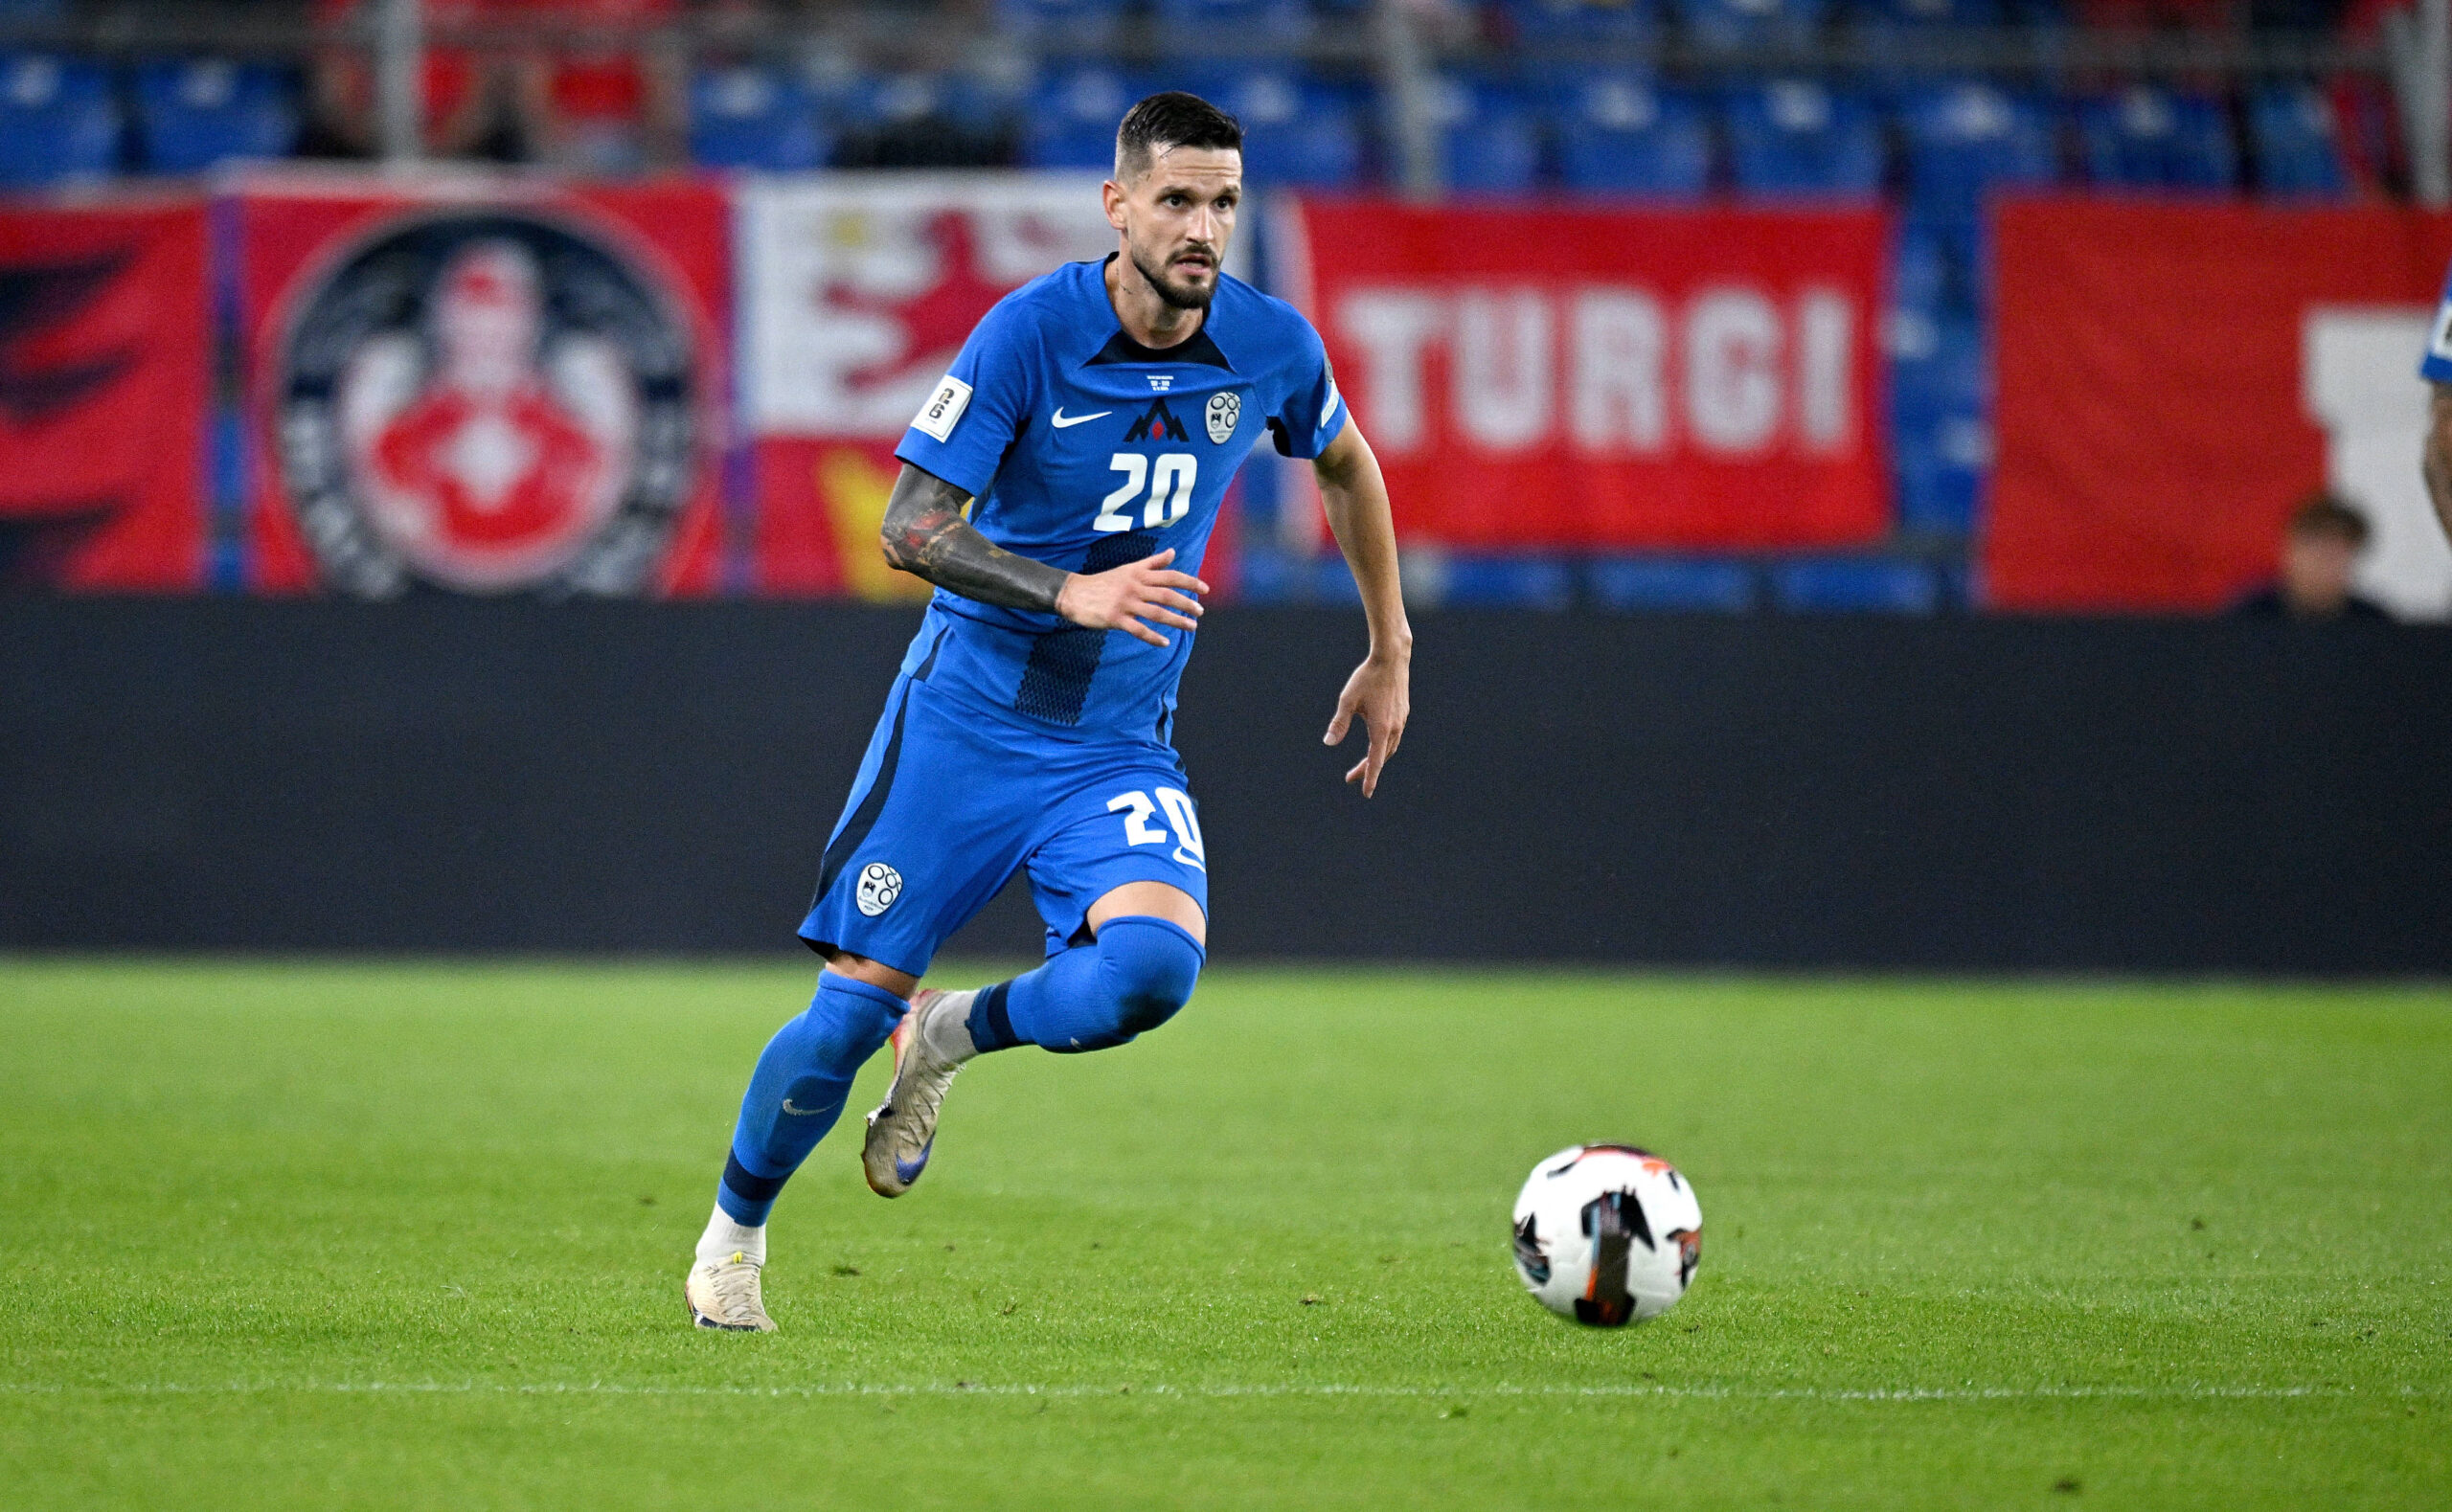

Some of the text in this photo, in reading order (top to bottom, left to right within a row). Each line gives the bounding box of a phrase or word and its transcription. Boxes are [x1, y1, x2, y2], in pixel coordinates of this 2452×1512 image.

[1343, 289, 1850, 452] TURGI
[1093, 453, 1197, 531] 20
[1106, 786, 1205, 863] 20
